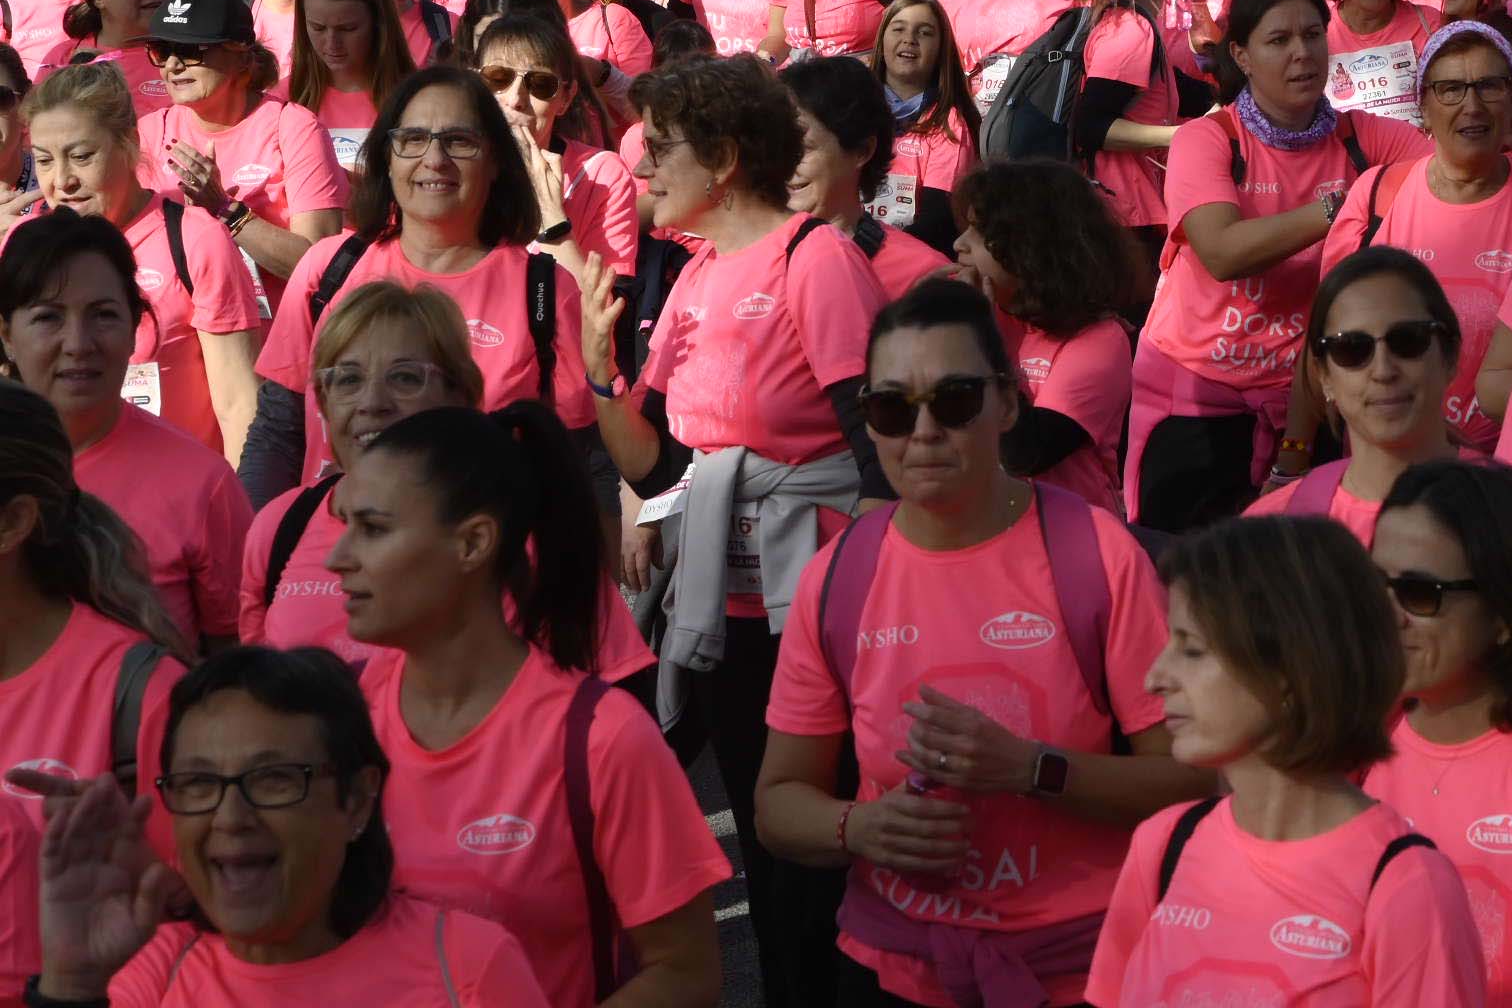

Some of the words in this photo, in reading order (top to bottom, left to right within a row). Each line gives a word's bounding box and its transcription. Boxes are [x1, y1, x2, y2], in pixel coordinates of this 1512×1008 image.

[163, 15, 188, 24] adidas
[1358, 76, 1388, 90] 016
[866, 205, 888, 217] 16
[535, 281, 545, 322] Quechua
[1222, 305, 1304, 338] DORS
[985, 624, 1050, 641] ASTURIANA
